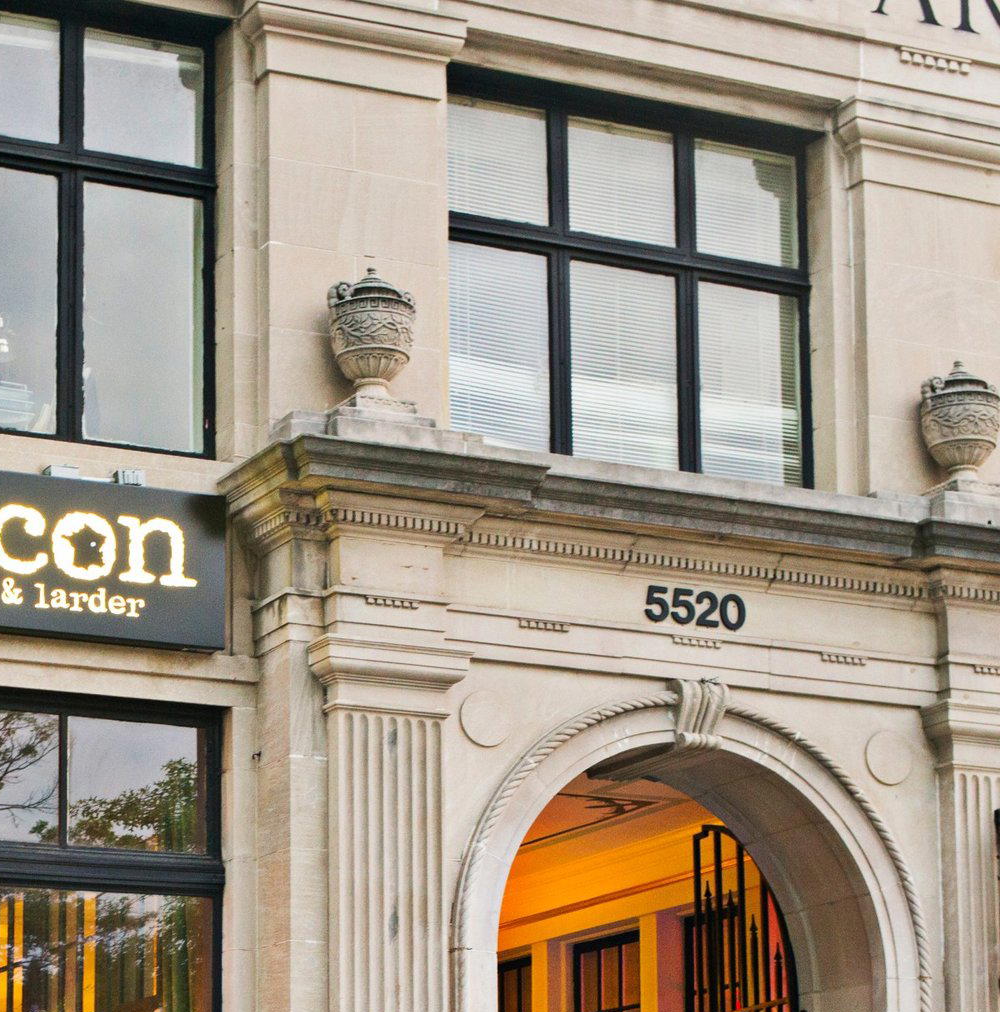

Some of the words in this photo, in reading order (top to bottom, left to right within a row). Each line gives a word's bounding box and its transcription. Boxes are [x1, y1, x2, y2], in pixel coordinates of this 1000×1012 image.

[0, 577, 24, 605] &
[34, 582, 146, 618] larder
[644, 584, 746, 632] 5520
